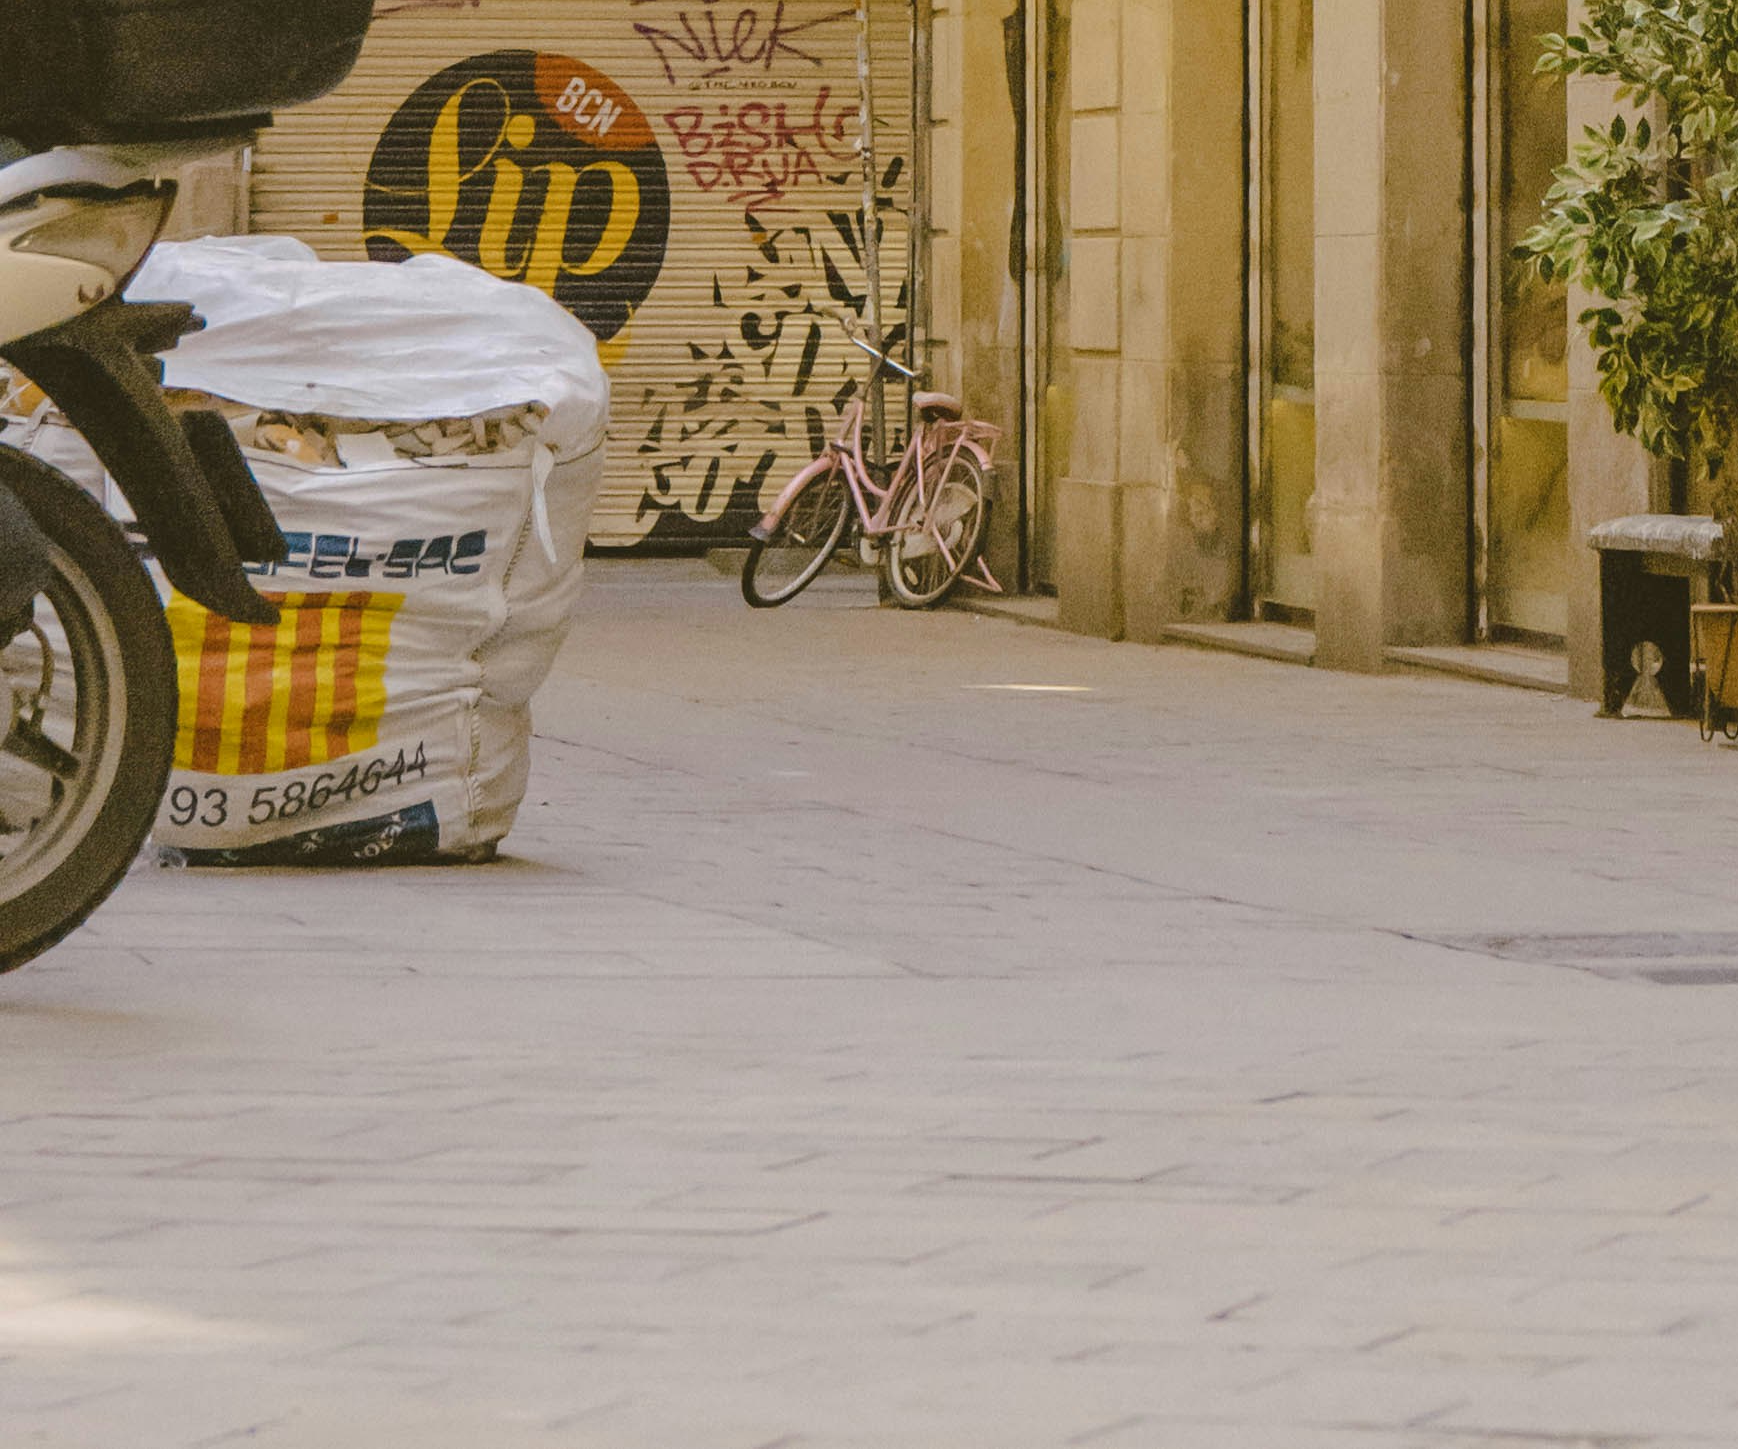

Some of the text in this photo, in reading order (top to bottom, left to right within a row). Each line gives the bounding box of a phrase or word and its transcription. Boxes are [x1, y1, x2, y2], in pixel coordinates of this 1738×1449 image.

[555, 76, 623, 139] BCN
[363, 77, 641, 299] Lip
[168, 740, 430, 828] 93 5864644
